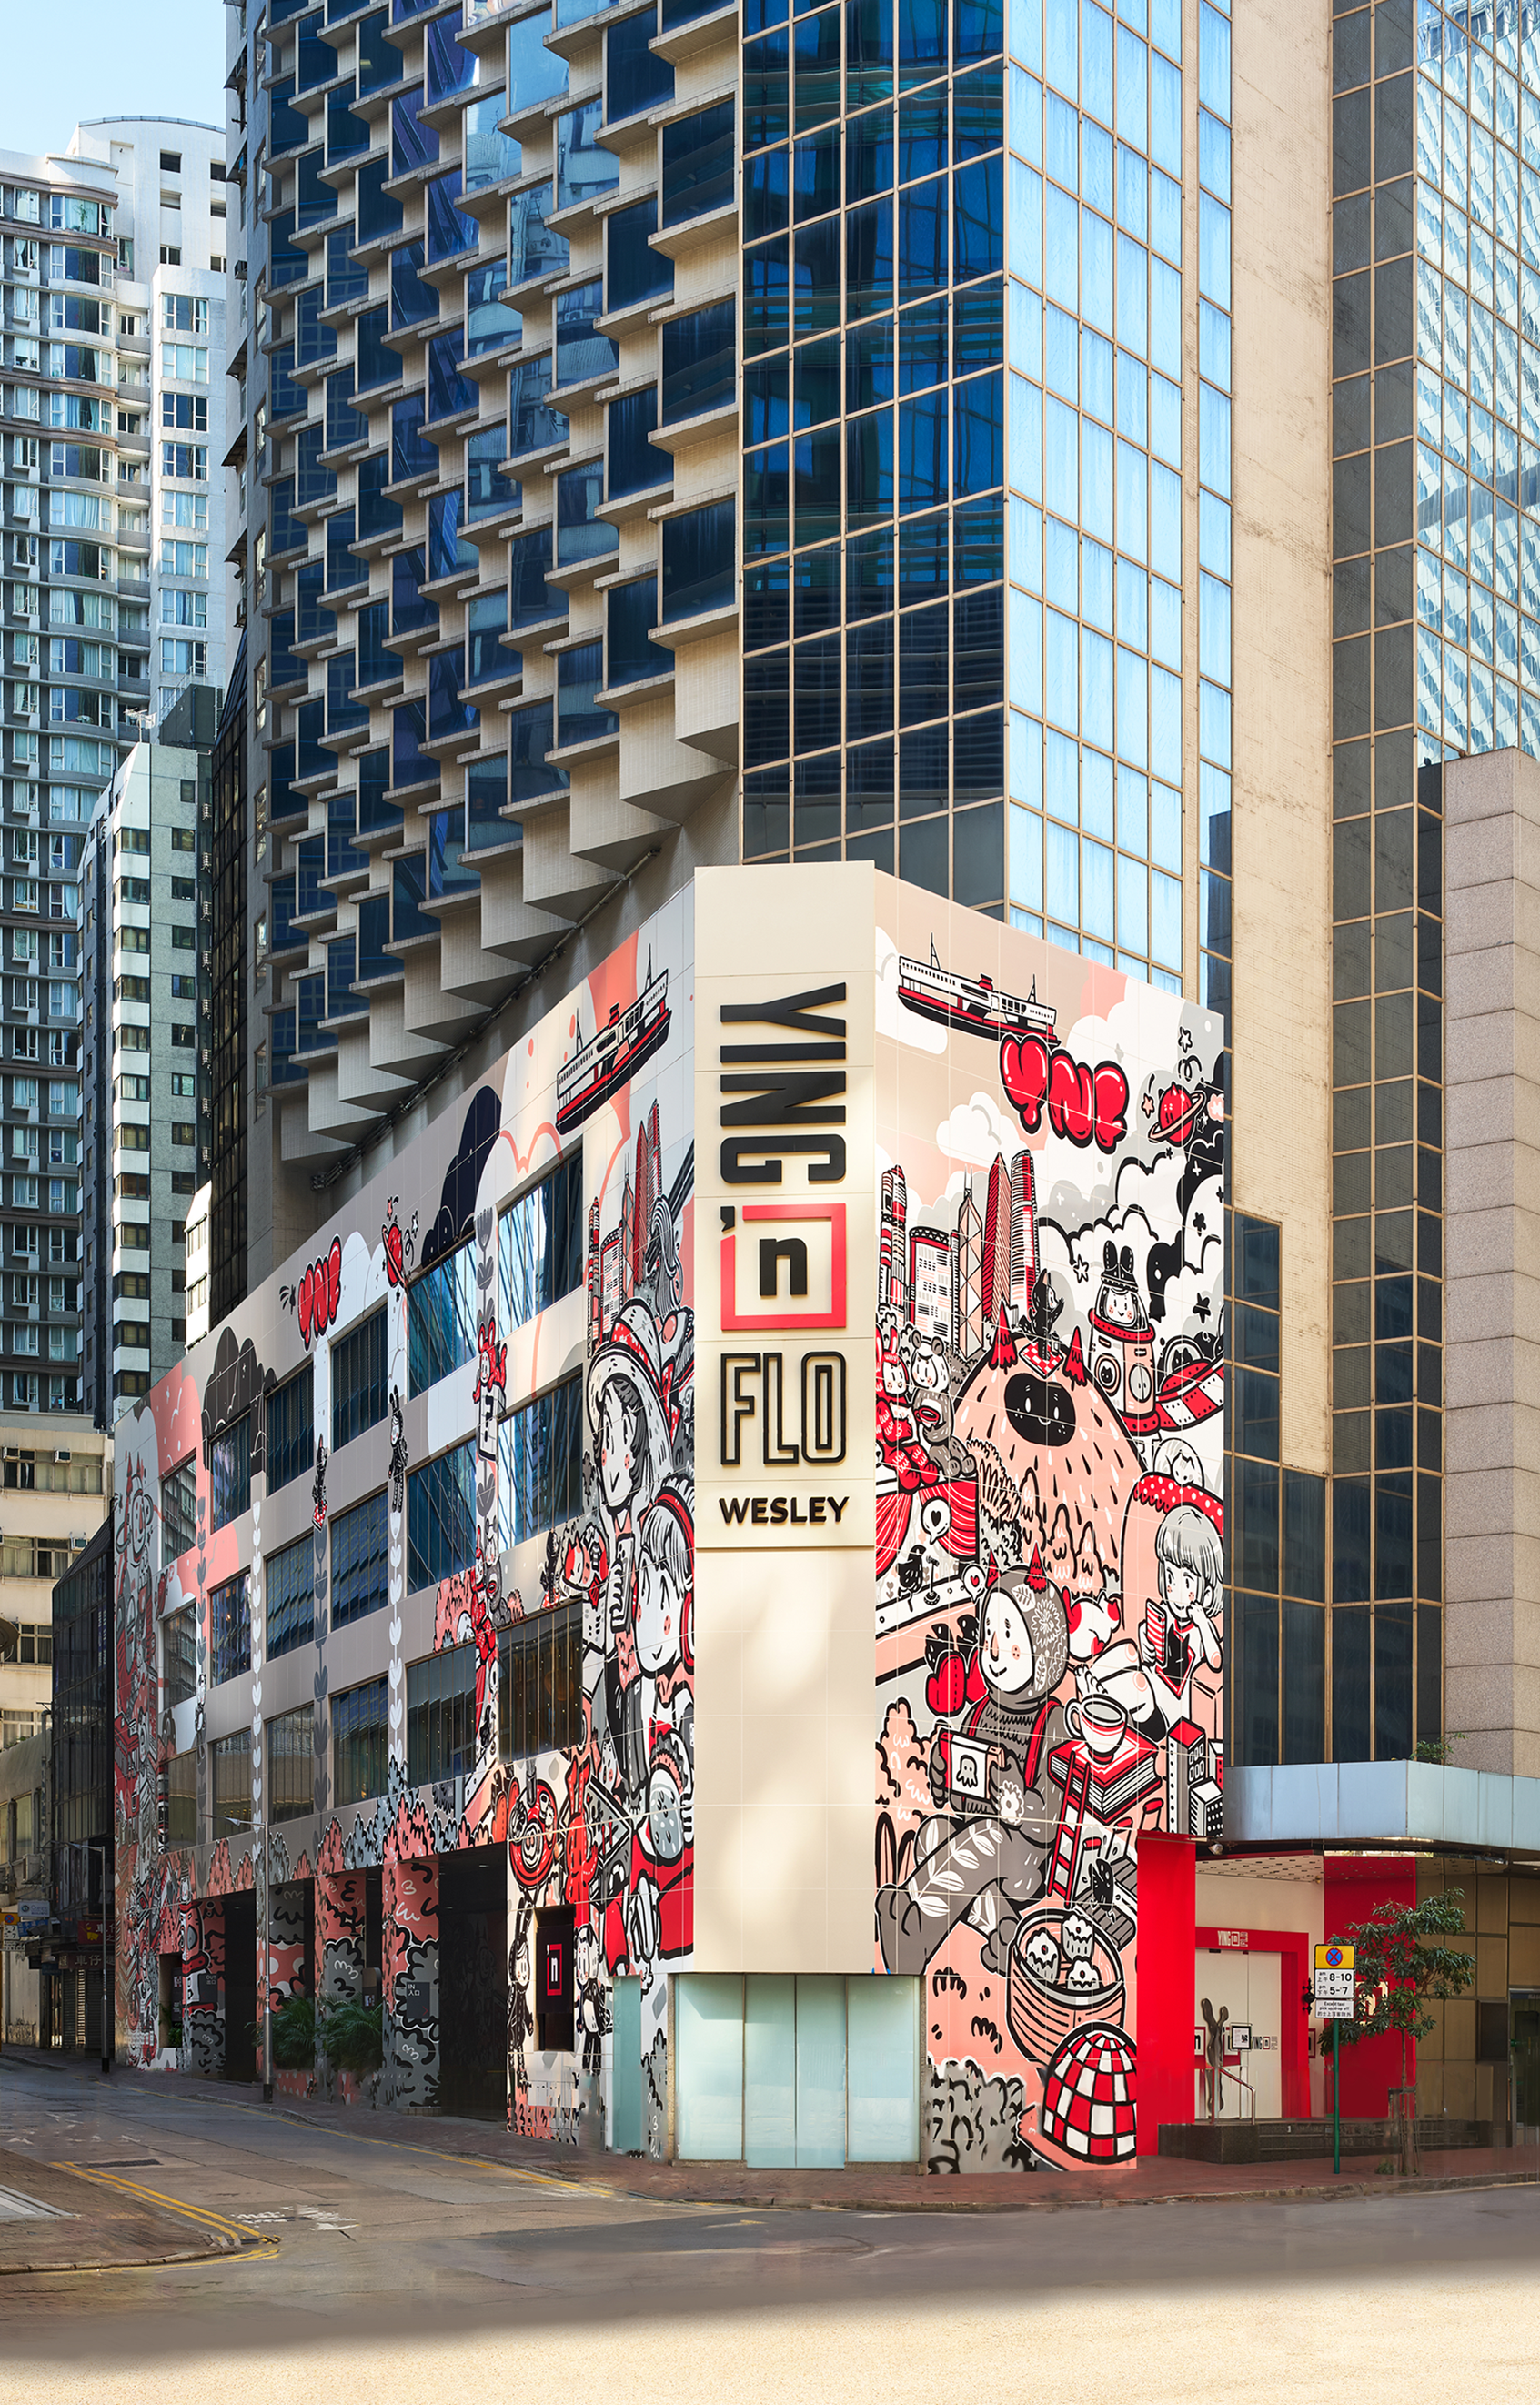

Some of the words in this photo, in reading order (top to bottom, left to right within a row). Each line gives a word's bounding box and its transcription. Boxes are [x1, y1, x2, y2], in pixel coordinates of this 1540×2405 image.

[720, 981, 847, 1184] YING
[720, 1352, 847, 1466] FLO
[720, 1495, 850, 1525] WESLEY
[1329, 1973, 1352, 1981] 8-10
[1329, 1987, 1348, 1995] 5-7
